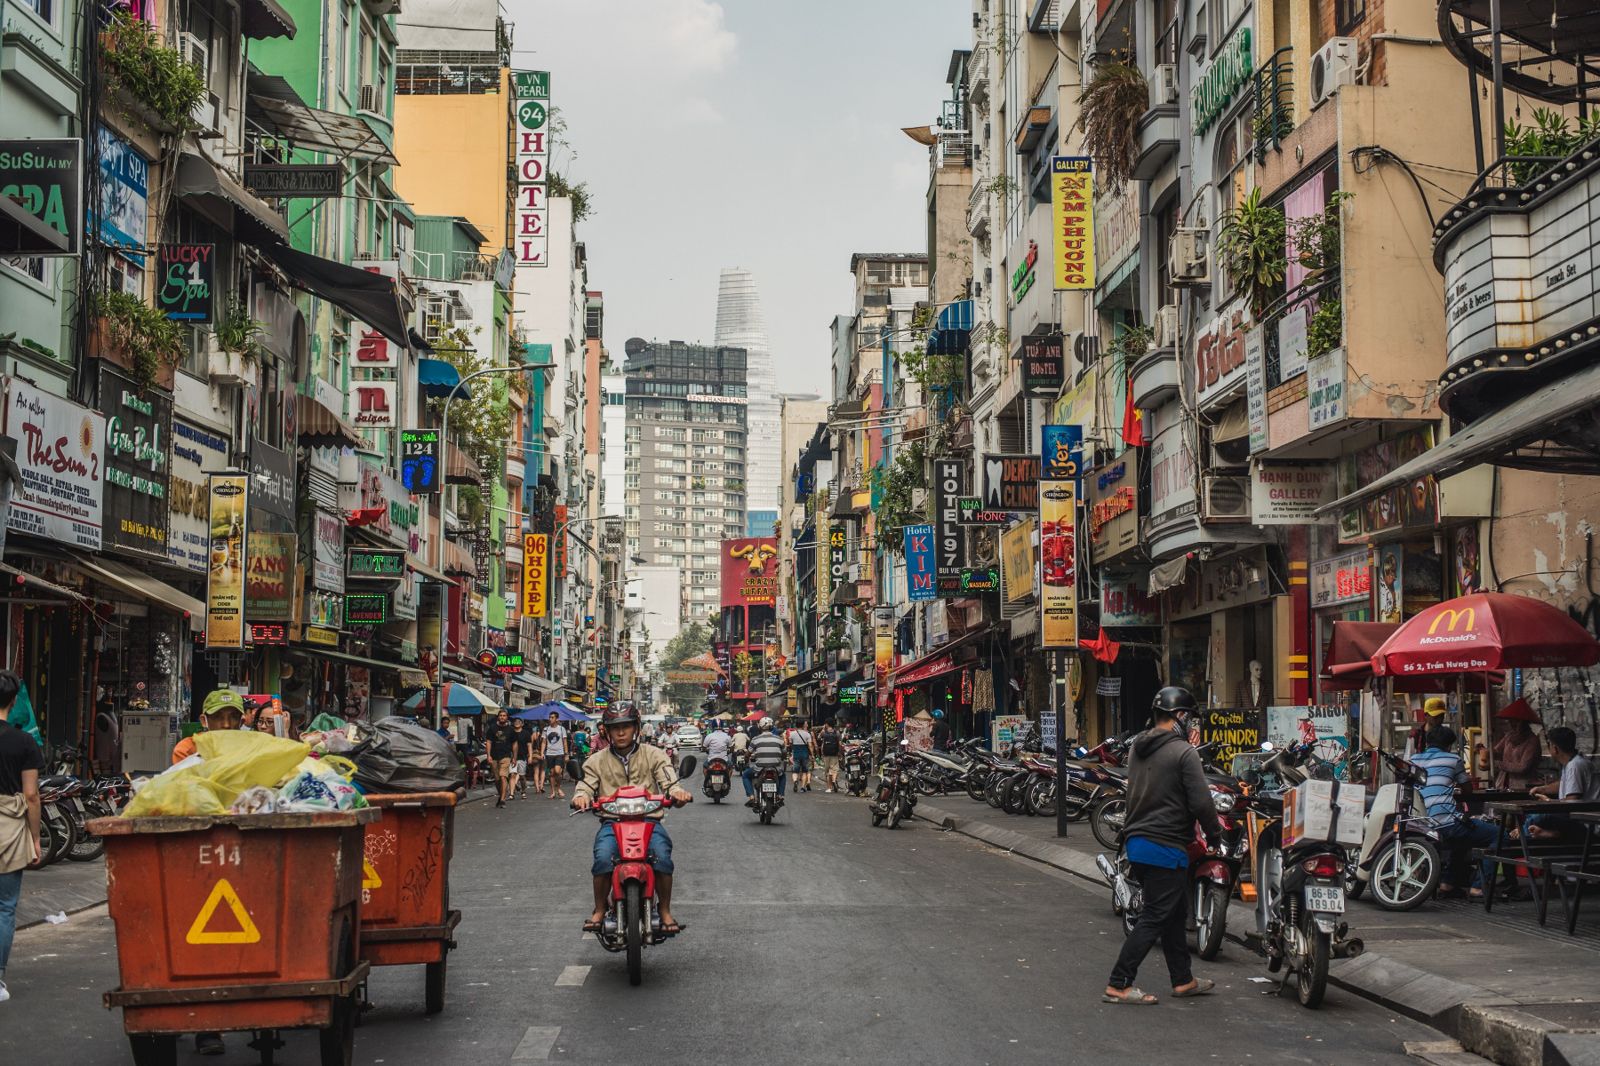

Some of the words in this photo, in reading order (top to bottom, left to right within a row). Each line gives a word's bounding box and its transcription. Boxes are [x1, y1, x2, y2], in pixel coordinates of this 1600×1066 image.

[527, 74, 540, 84] VN
[518, 86, 547, 96] PEARL
[522, 108, 542, 122] 94
[0, 152, 44, 169] SuSu
[1056, 161, 1089, 170] GALLERY
[128, 152, 147, 188] SPA
[300, 172, 333, 190] TATTOO
[521, 132, 544, 261] HOTEL
[1060, 177, 1088, 212] NAM
[162, 246, 210, 262] LUCKY
[1546, 268, 1565, 288] Lunch
[1566, 264, 1577, 276] Set
[160, 264, 210, 311] Spa
[188, 260, 204, 285] 1
[1475, 290, 1492, 307] beers
[1046, 346, 1062, 358] ANH
[1030, 362, 1056, 375] HOSTEL
[22, 422, 53, 466] The
[52, 436, 88, 476] Sun
[91, 452, 98, 481] 2
[406, 443, 432, 454] 124
[22, 468, 39, 483] WHOLE
[74, 484, 90, 496] PRICES
[944, 465, 958, 536] HOTEL
[1269, 488, 1322, 499] GALLERY
[961, 500, 980, 510] NHA
[907, 526, 930, 536] Hotel
[526, 536, 546, 554] 96
[831, 532, 844, 548] 65
[944, 538, 958, 566] 97
[352, 554, 402, 572] HOTEL
[912, 536, 932, 590] KIM
[528, 556, 543, 615] HOTEL
[746, 578, 776, 586] CRAZY
[832, 552, 842, 616] HOTL
[352, 600, 379, 610] SPA
[1420, 633, 1476, 645] McDonald's
[1404, 662, 1414, 672] Số
[1416, 663, 1425, 671] 2,
[1426, 660, 1444, 670] Trần
[1446, 660, 1468, 670] Hưng
[1470, 658, 1487, 668] Đạo
[1210, 712, 1244, 726] Capital
[1308, 706, 1348, 718] SAIGON
[1204, 730, 1258, 746] LAUNDRY
[200, 844, 241, 866] E14
